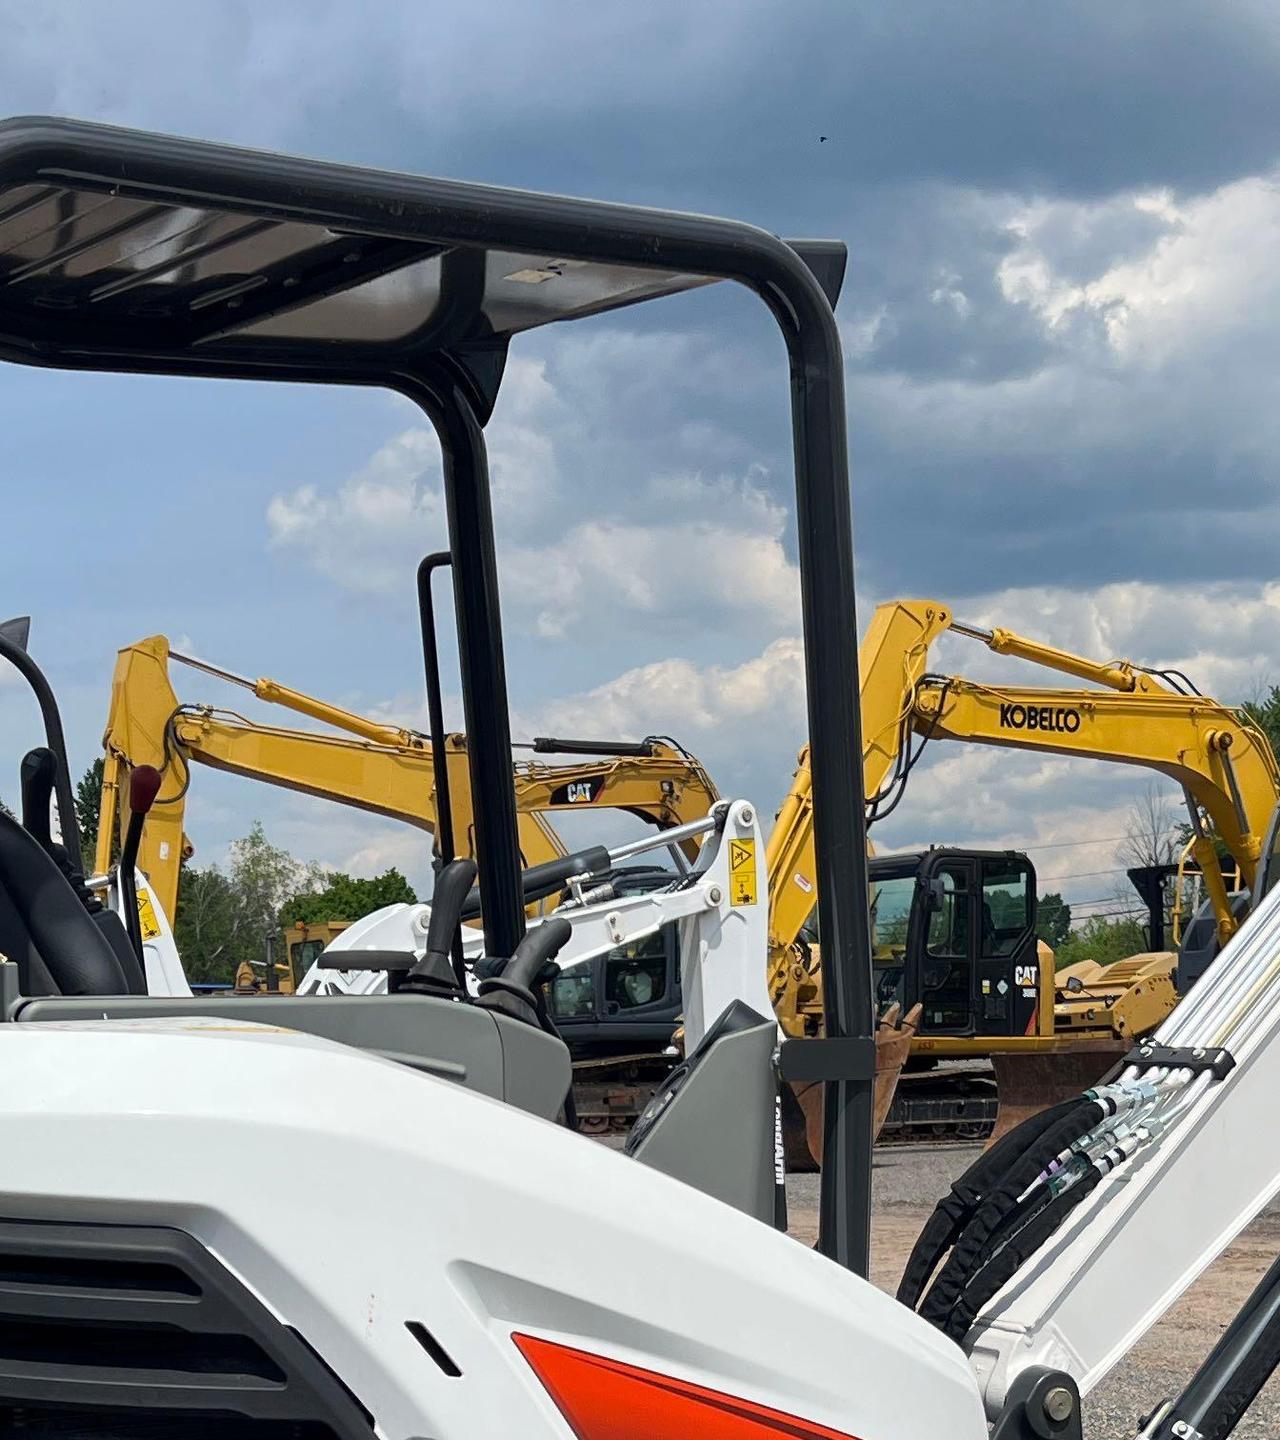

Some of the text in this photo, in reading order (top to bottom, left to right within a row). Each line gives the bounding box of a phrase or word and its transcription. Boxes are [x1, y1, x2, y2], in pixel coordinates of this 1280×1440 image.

[999, 703, 1081, 734] KOBELCO
[567, 782, 592, 804] CAT
[1014, 965, 1038, 986] CAT
